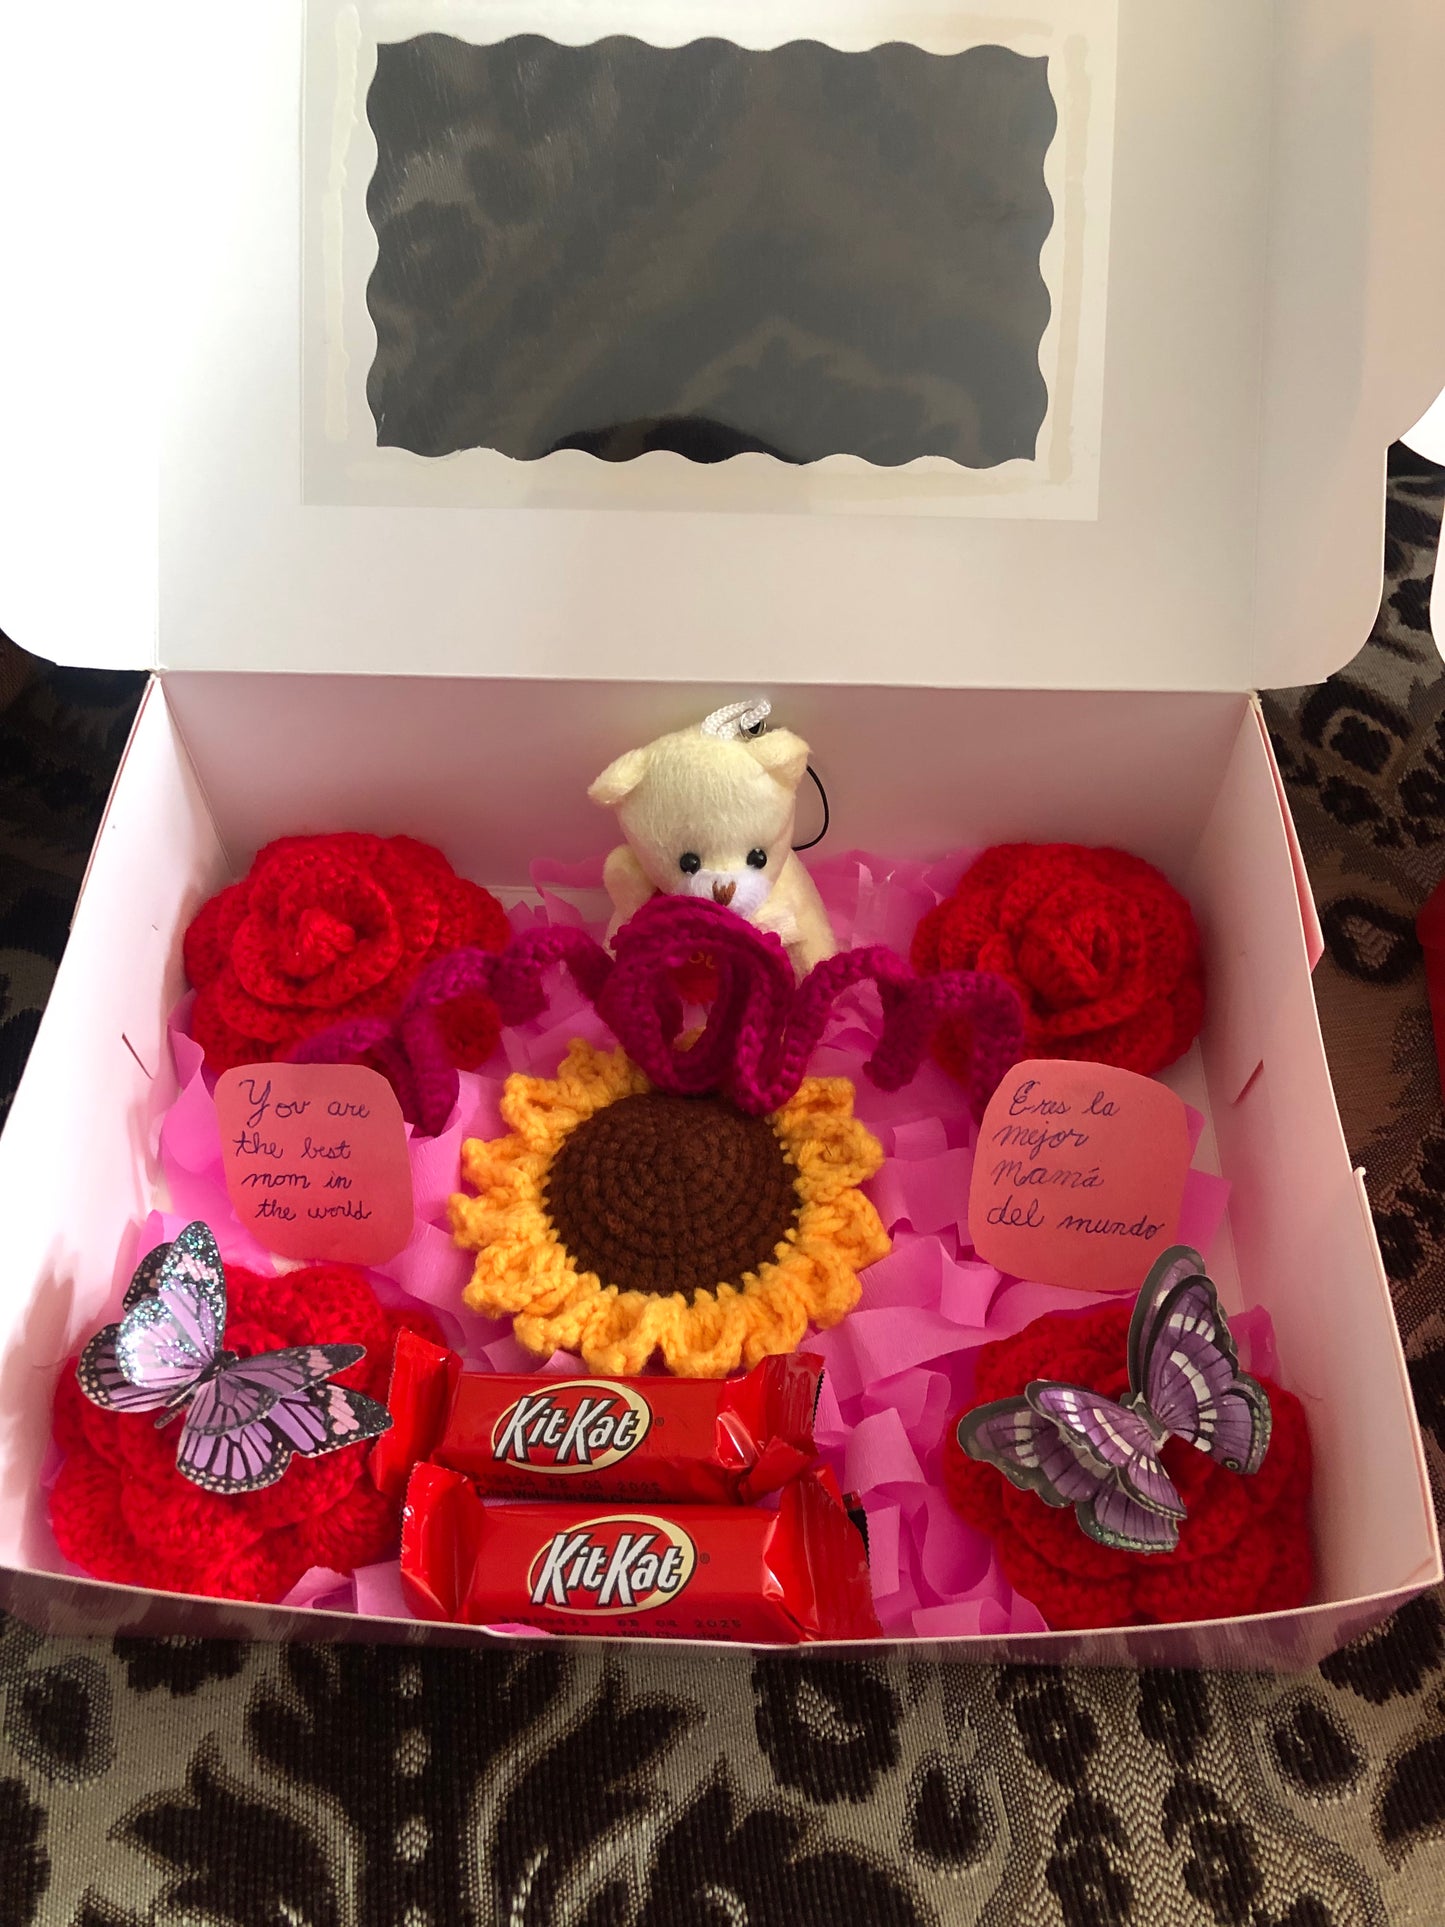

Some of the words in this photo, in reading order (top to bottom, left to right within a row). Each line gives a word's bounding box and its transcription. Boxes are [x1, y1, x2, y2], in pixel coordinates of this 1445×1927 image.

[327, 1100, 370, 1118] are
[1009, 1080, 1071, 1116] Eres
[1082, 1091, 1120, 1117] la
[233, 1131, 283, 1159] the
[301, 1137, 351, 1159] best
[992, 1121, 1089, 1160] mejor
[241, 1173, 311, 1189] mom
[324, 1171, 352, 1189] in
[254, 1199, 296, 1221] the
[307, 1200, 372, 1221] world
[986, 1194, 1045, 1228] del
[1057, 1215, 1165, 1240] mundo
[492, 1394, 641, 1465] KitKat
[530, 1532, 685, 1607] KitKat
[694, 1619, 742, 1628] 2025
